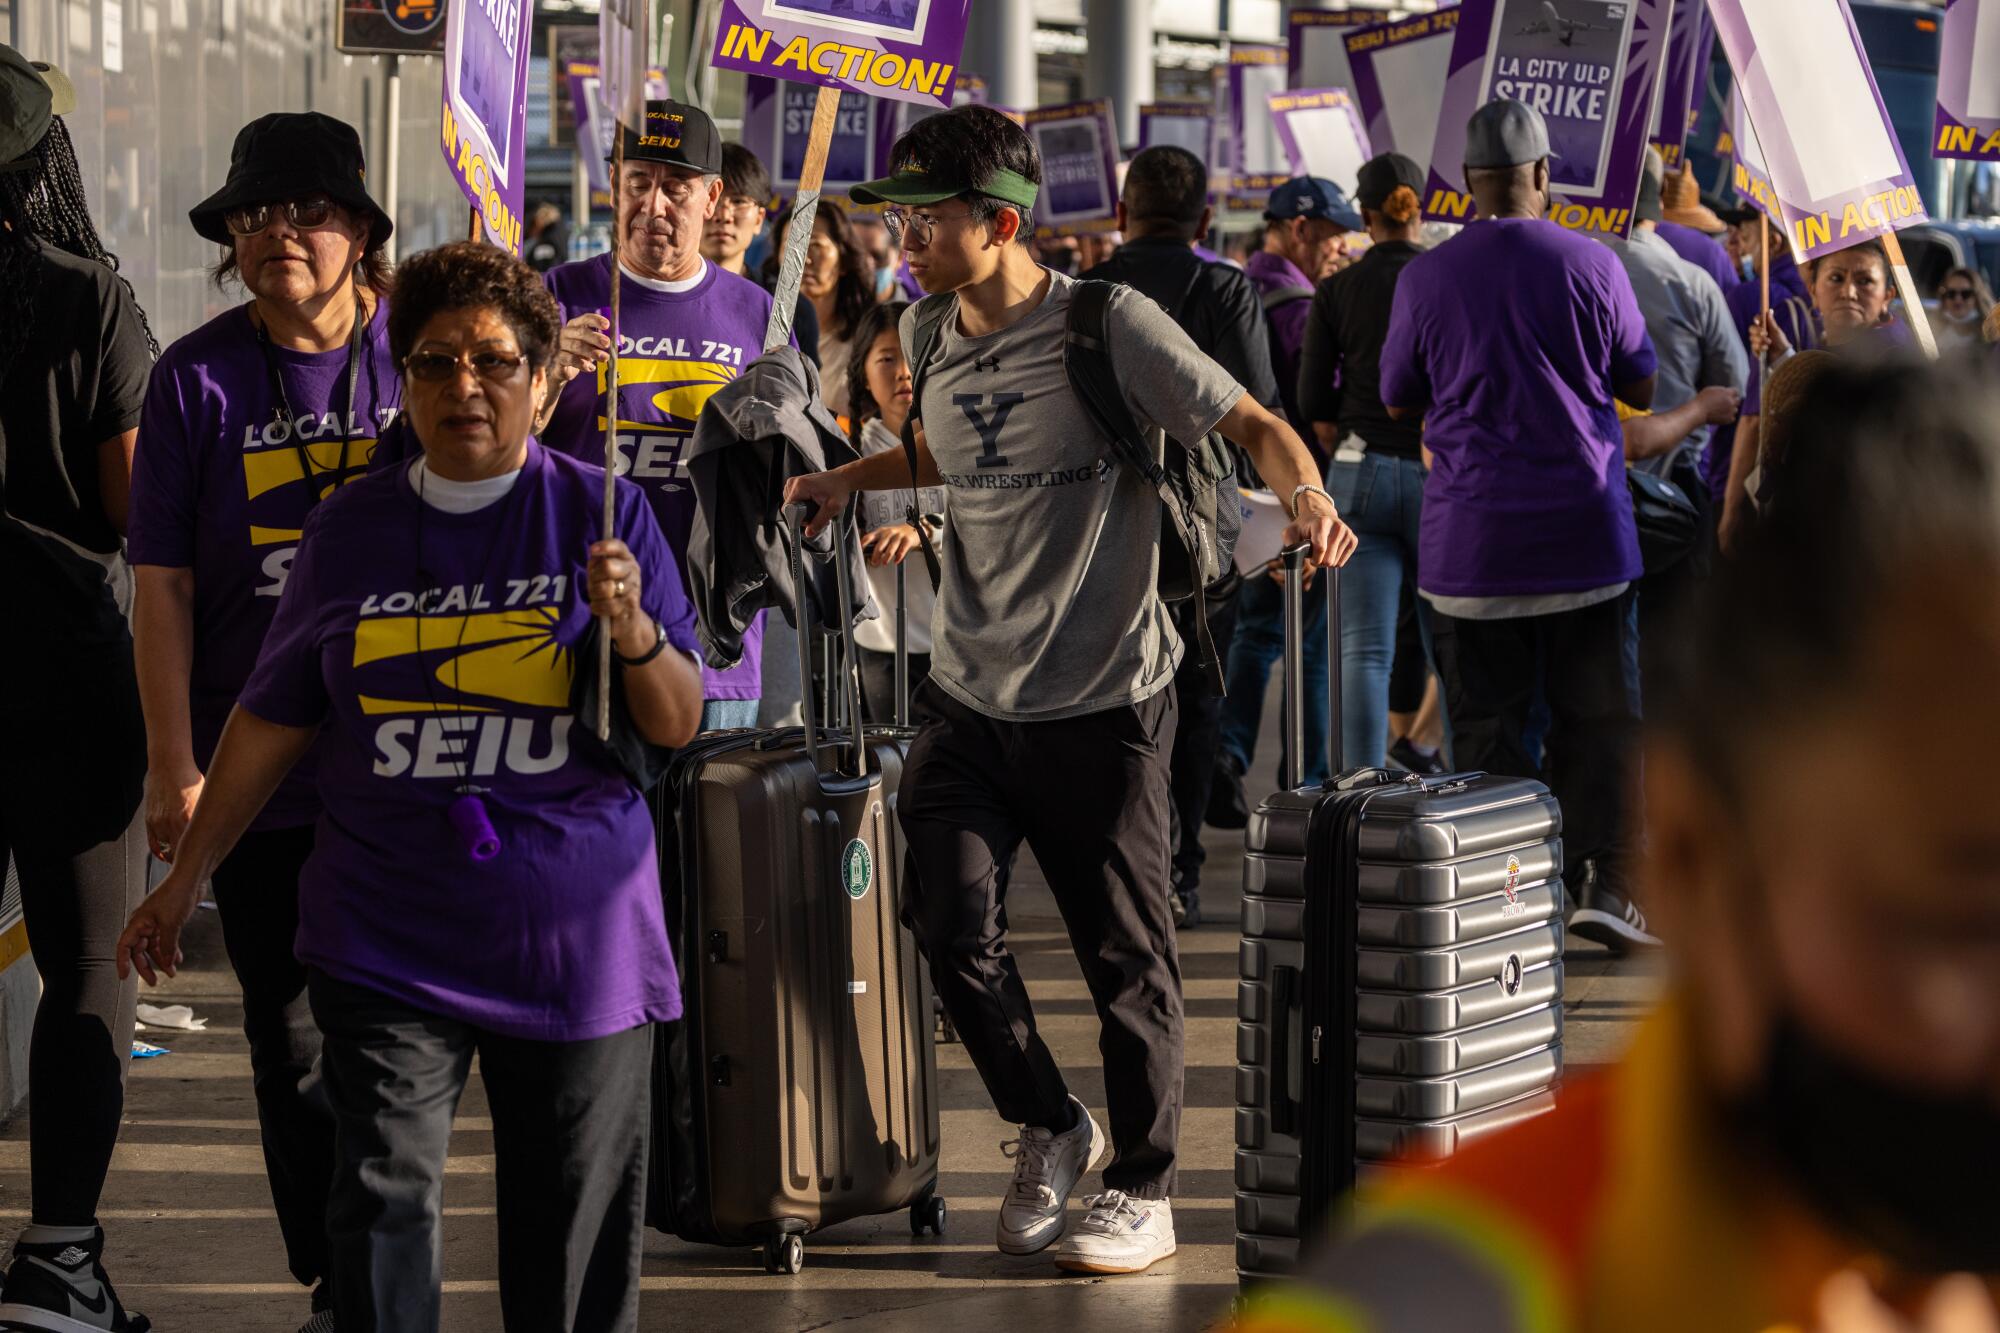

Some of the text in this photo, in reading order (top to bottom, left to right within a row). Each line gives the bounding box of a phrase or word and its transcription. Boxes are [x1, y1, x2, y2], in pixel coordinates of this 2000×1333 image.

[719, 24, 954, 97] IN ACTION!
[1498, 56, 1611, 85] LA CITY ULP
[670, 114, 684, 123] 721
[785, 108, 866, 136] STKE
[638, 135, 680, 149] SEIU
[1937, 125, 1977, 152] IN
[442, 101, 521, 257] IN ACTION!
[1427, 189, 1472, 218] IN
[1795, 211, 1832, 252] IN
[619, 336, 743, 365] OCAL 721
[242, 411, 365, 449] LOCAL
[953, 392, 1024, 468] Y
[965, 466, 1092, 489] WRESTLING
[359, 575, 567, 615] LOCAL 721
[373, 716, 575, 778] SEIU
[1503, 903, 1525, 918] BROWN
